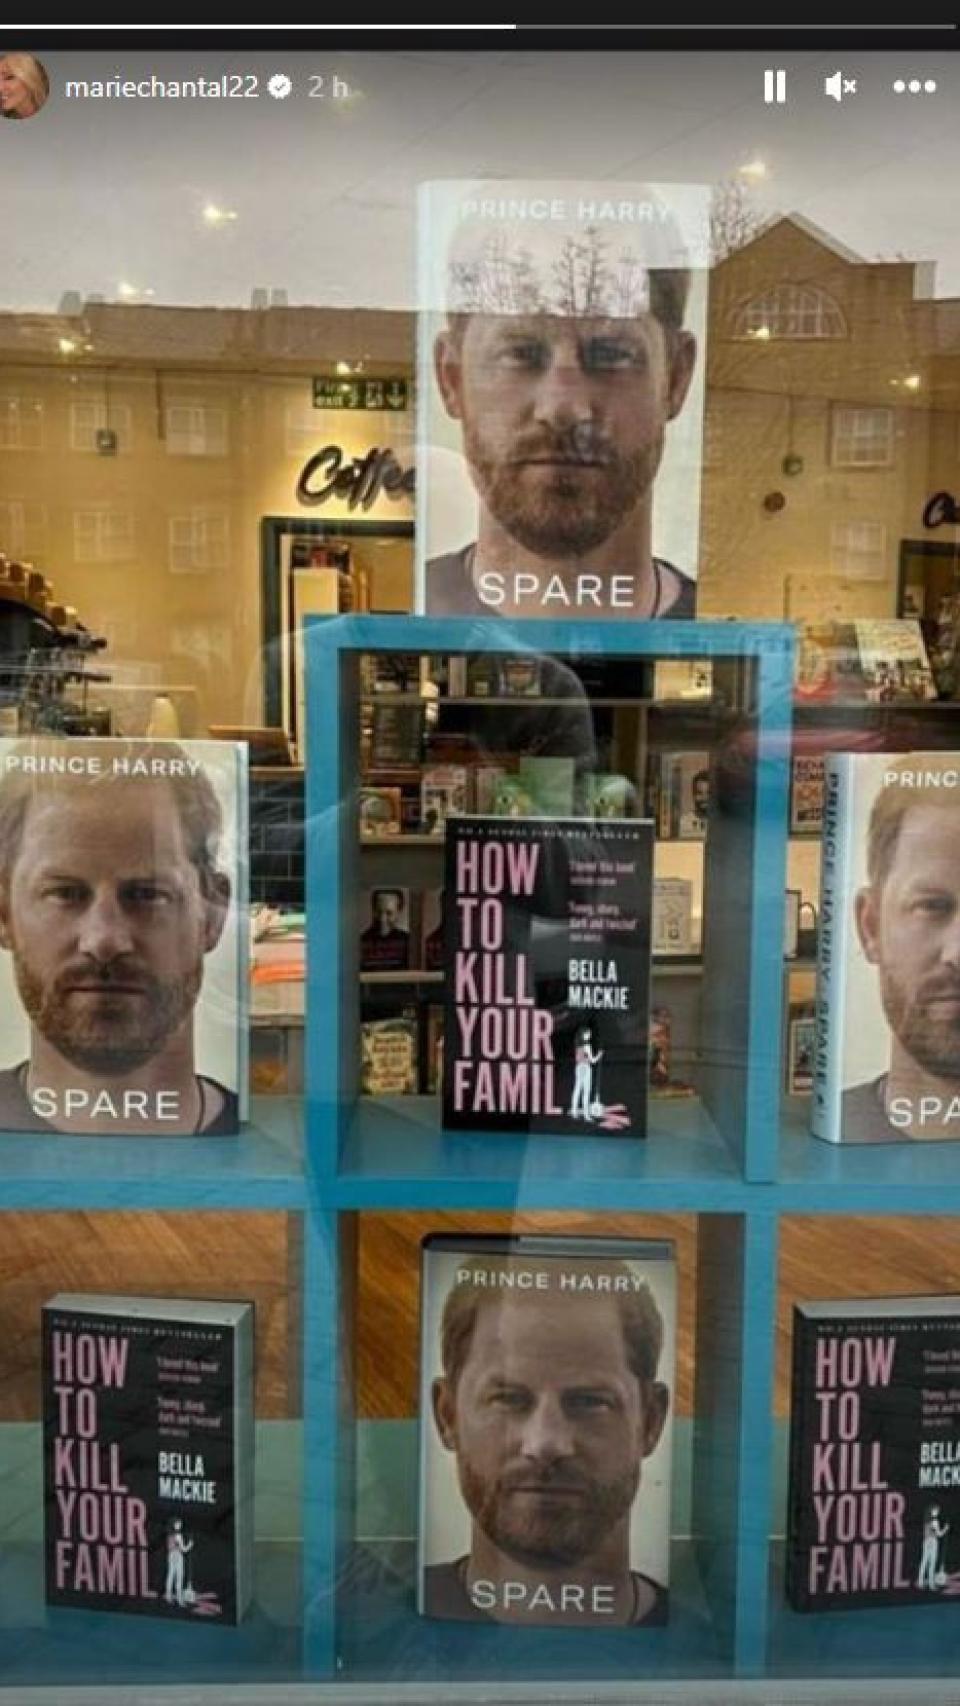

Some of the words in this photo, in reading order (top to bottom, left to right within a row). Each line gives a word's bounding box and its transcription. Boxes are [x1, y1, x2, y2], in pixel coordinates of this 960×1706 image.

[461, 199, 568, 220] PRINCE
[577, 201, 672, 221] HARRY
[478, 572, 635, 608] SPARE
[5, 756, 101, 775] PRINCE
[112, 758, 202, 777] HARRY
[456, 841, 540, 896] HOW
[456, 898, 503, 950] TO
[455, 953, 535, 1006] KILL
[568, 959, 618, 983] BELLA
[568, 986, 630, 1010] MACKIE
[456, 1007, 554, 1061] YOUR
[32, 1088, 181, 1121] SPARE
[454, 1061, 563, 1115] FAMIL
[456, 1269, 549, 1290] PRINCE
[560, 1272, 646, 1292] HARRY
[53, 1331, 129, 1388] HOW
[815, 1337, 897, 1388] HOW
[54, 1387, 97, 1438] TO
[815, 1391, 860, 1441] TO
[54, 1438, 128, 1493] KILL
[158, 1452, 205, 1477] BELLA
[158, 1477, 217, 1503] MACKIE
[813, 1441, 889, 1492] KILL
[56, 1490, 148, 1547] YOUR
[813, 1492, 906, 1543] YOUR
[55, 1540, 159, 1598] FAMIL
[808, 1542, 911, 1595] FAMIL
[471, 1580, 615, 1614] SPARE
